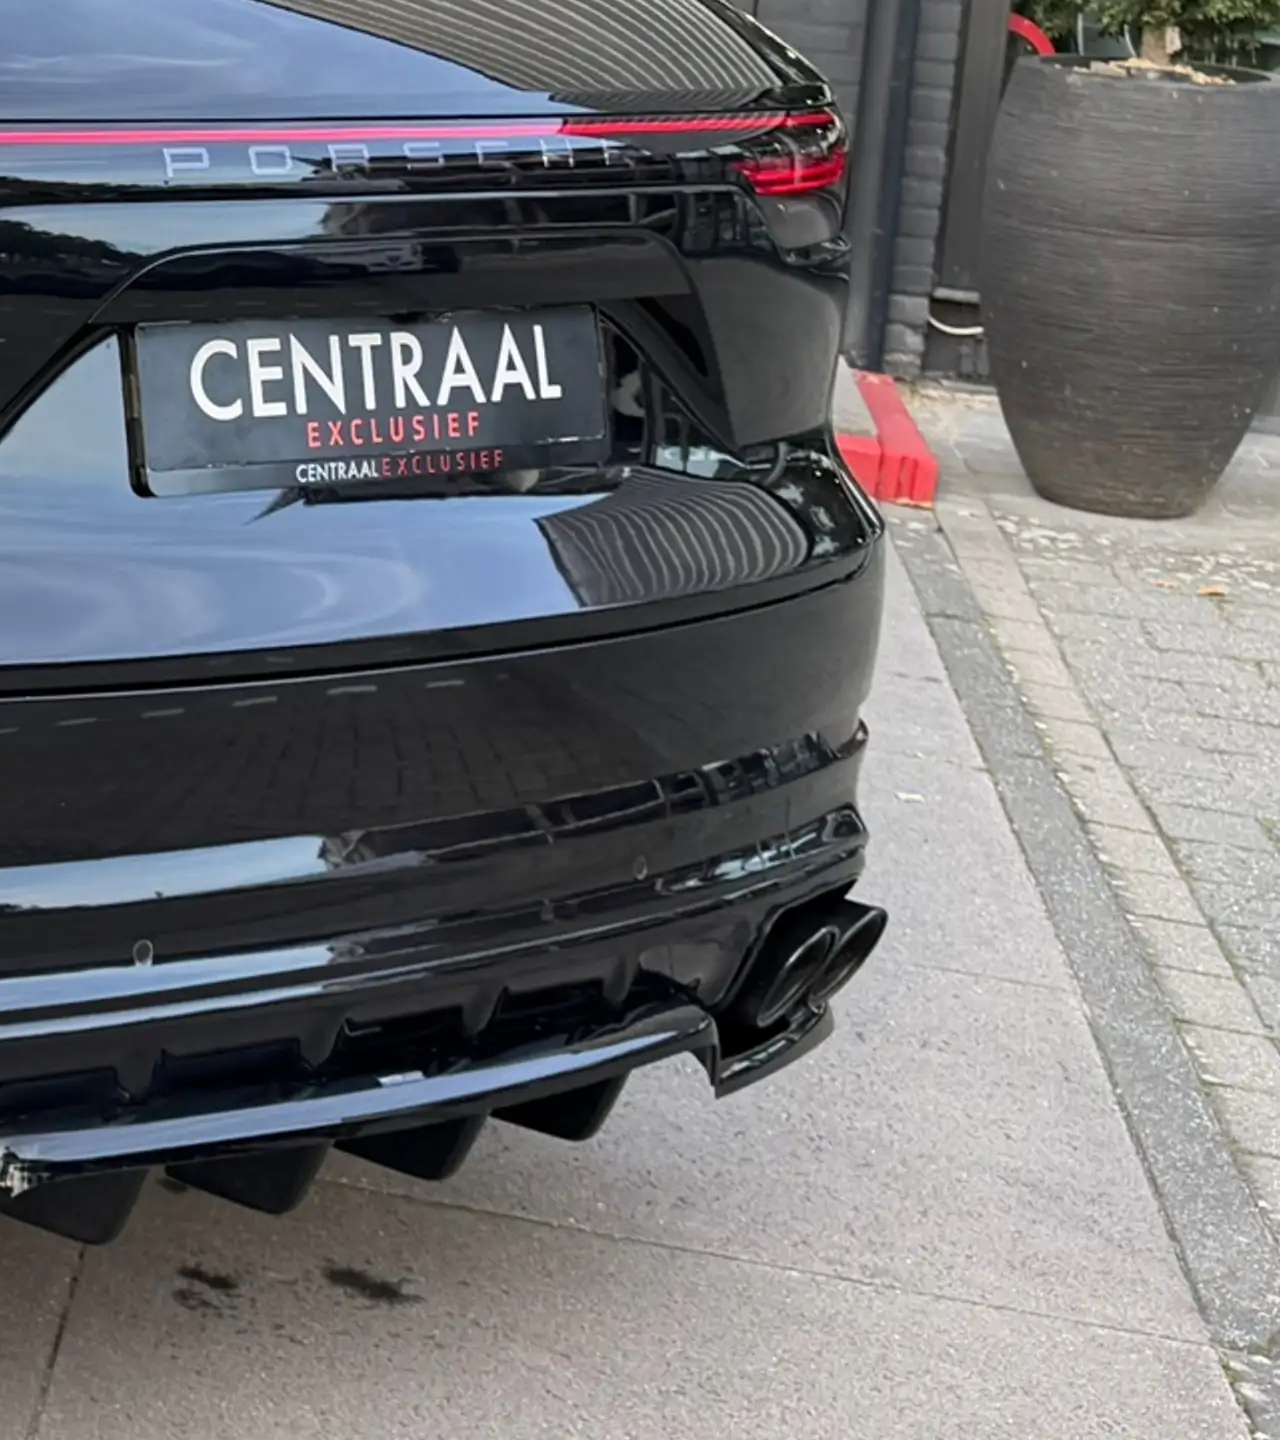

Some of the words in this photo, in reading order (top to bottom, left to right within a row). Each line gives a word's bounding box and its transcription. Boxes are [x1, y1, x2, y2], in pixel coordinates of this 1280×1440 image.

[162, 138, 634, 177] PORSCHE
[190, 323, 563, 421] CENTRAAL
[306, 411, 481, 448] EXCLUSIEF
